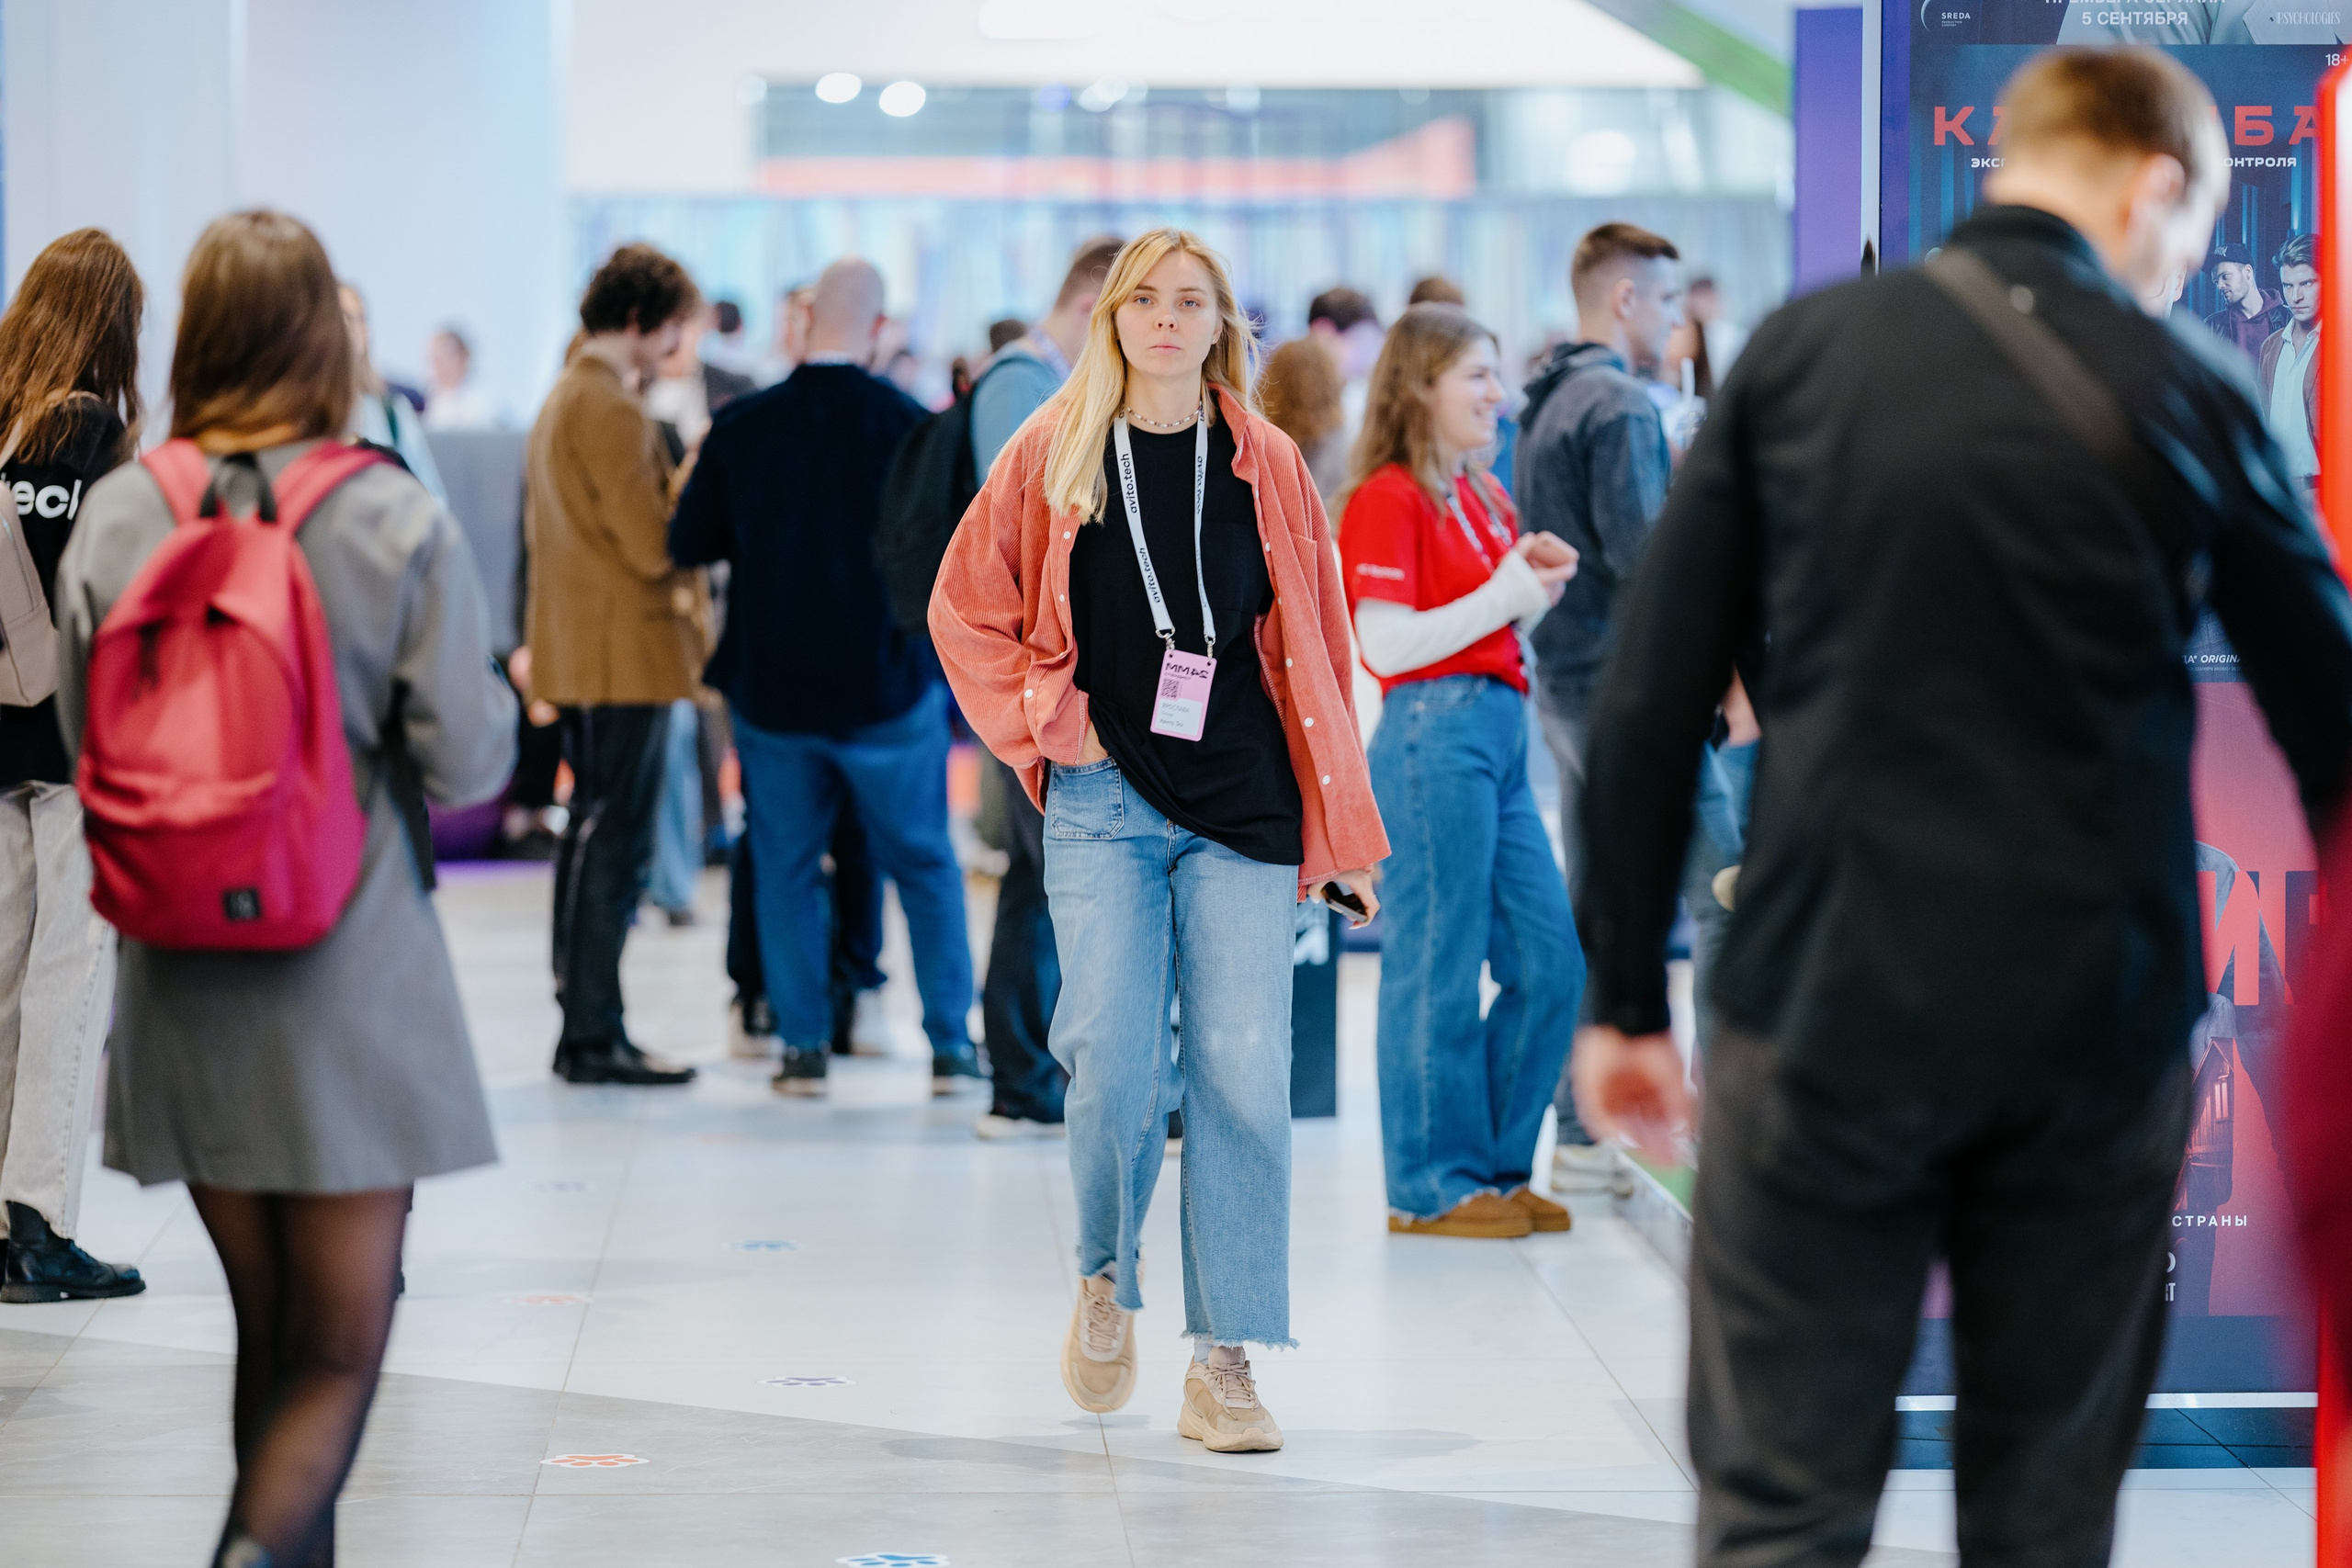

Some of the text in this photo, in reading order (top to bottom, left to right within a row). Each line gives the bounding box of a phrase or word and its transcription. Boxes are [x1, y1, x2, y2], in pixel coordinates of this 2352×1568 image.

[2082, 12, 2188, 25] 5 СЕНТЯБРЯ
[2278, 11, 2341, 25] PSYCHOLOGIES
[2325, 53, 2348, 66] 18+
[1121, 453, 1137, 513] avito.tech
[2172, 1215, 2247, 1227] СТРАНЫ
